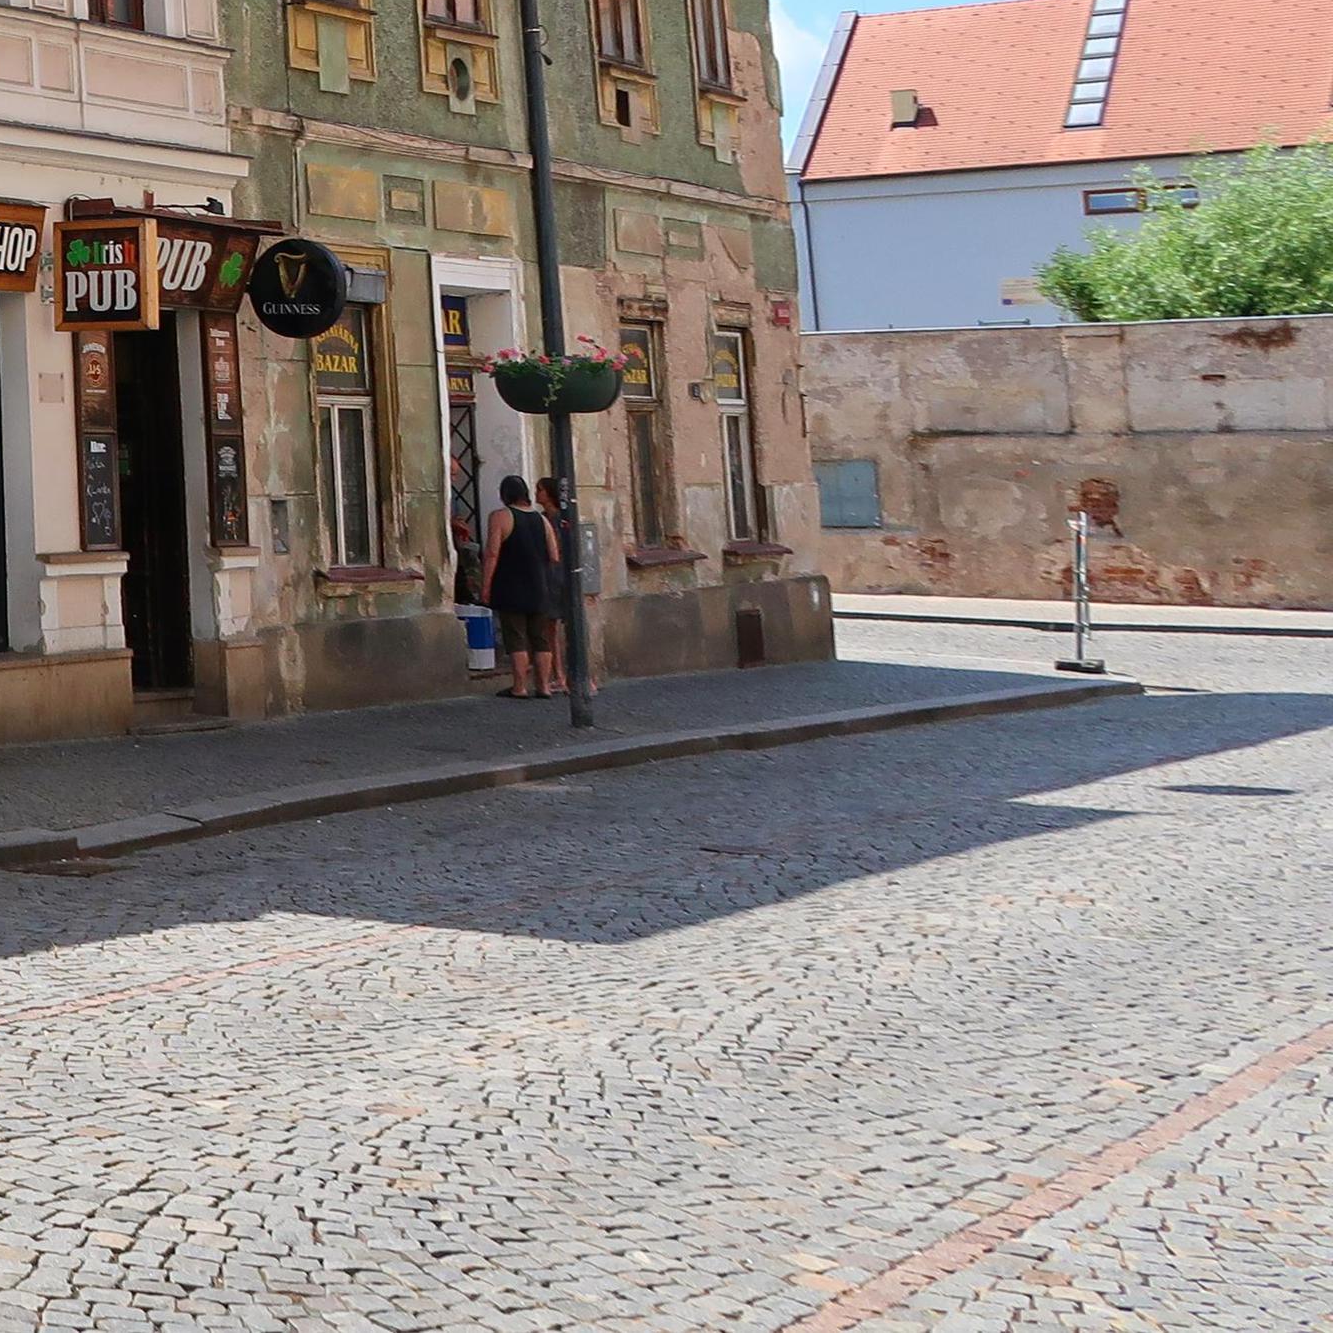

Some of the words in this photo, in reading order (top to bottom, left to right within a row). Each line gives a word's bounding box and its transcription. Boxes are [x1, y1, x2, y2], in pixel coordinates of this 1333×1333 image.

[93, 239, 135, 265] Irish
[65, 269, 137, 312] PUB
[263, 301, 321, 315] GUINNESS
[316, 354, 358, 373] BAZAR
